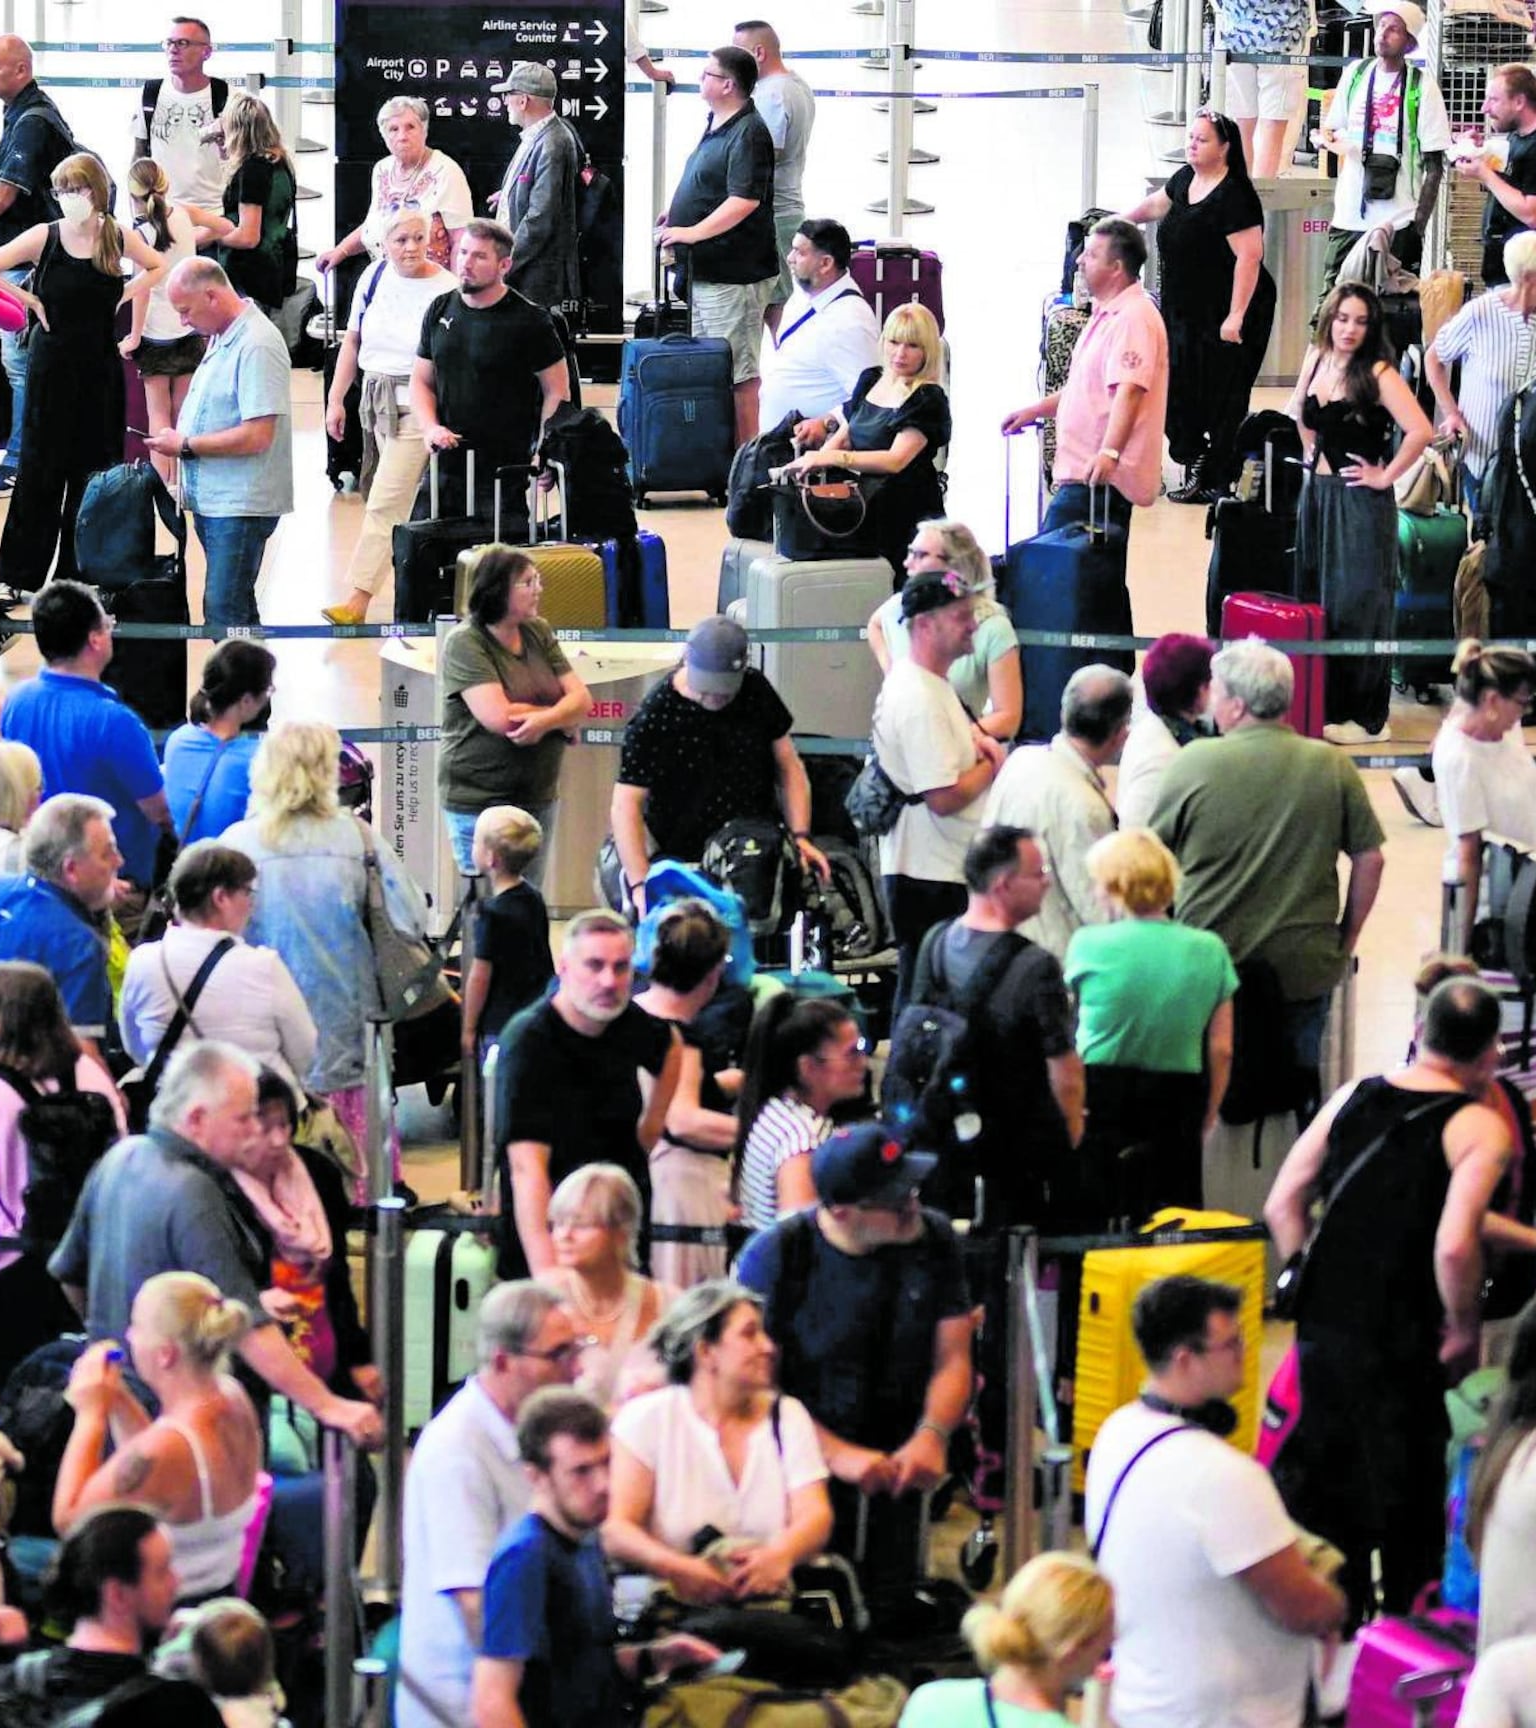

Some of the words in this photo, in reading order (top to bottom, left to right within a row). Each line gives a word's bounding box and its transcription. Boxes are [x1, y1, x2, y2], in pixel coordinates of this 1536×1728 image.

[482, 20, 517, 31] Airline
[520, 20, 557, 31] Service
[516, 32, 557, 42] Counter
[366, 57, 404, 69] Airport
[384, 69, 404, 81] City
[1303, 220, 1329, 233] BER
[227, 626, 251, 638] BER
[380, 625, 404, 637] BER
[557, 629, 581, 641] BER
[1071, 635, 1096, 647] BER
[1374, 641, 1399, 653] BER
[587, 702, 623, 719] BER
[417, 729, 441, 741] BER
[587, 730, 612, 742] BER
[409, 765, 418, 776] to
[395, 773, 405, 786] zu
[410, 780, 418, 794] us
[395, 790, 405, 810] uns
[408, 797, 420, 823] Help
[393, 815, 405, 831] Sie
